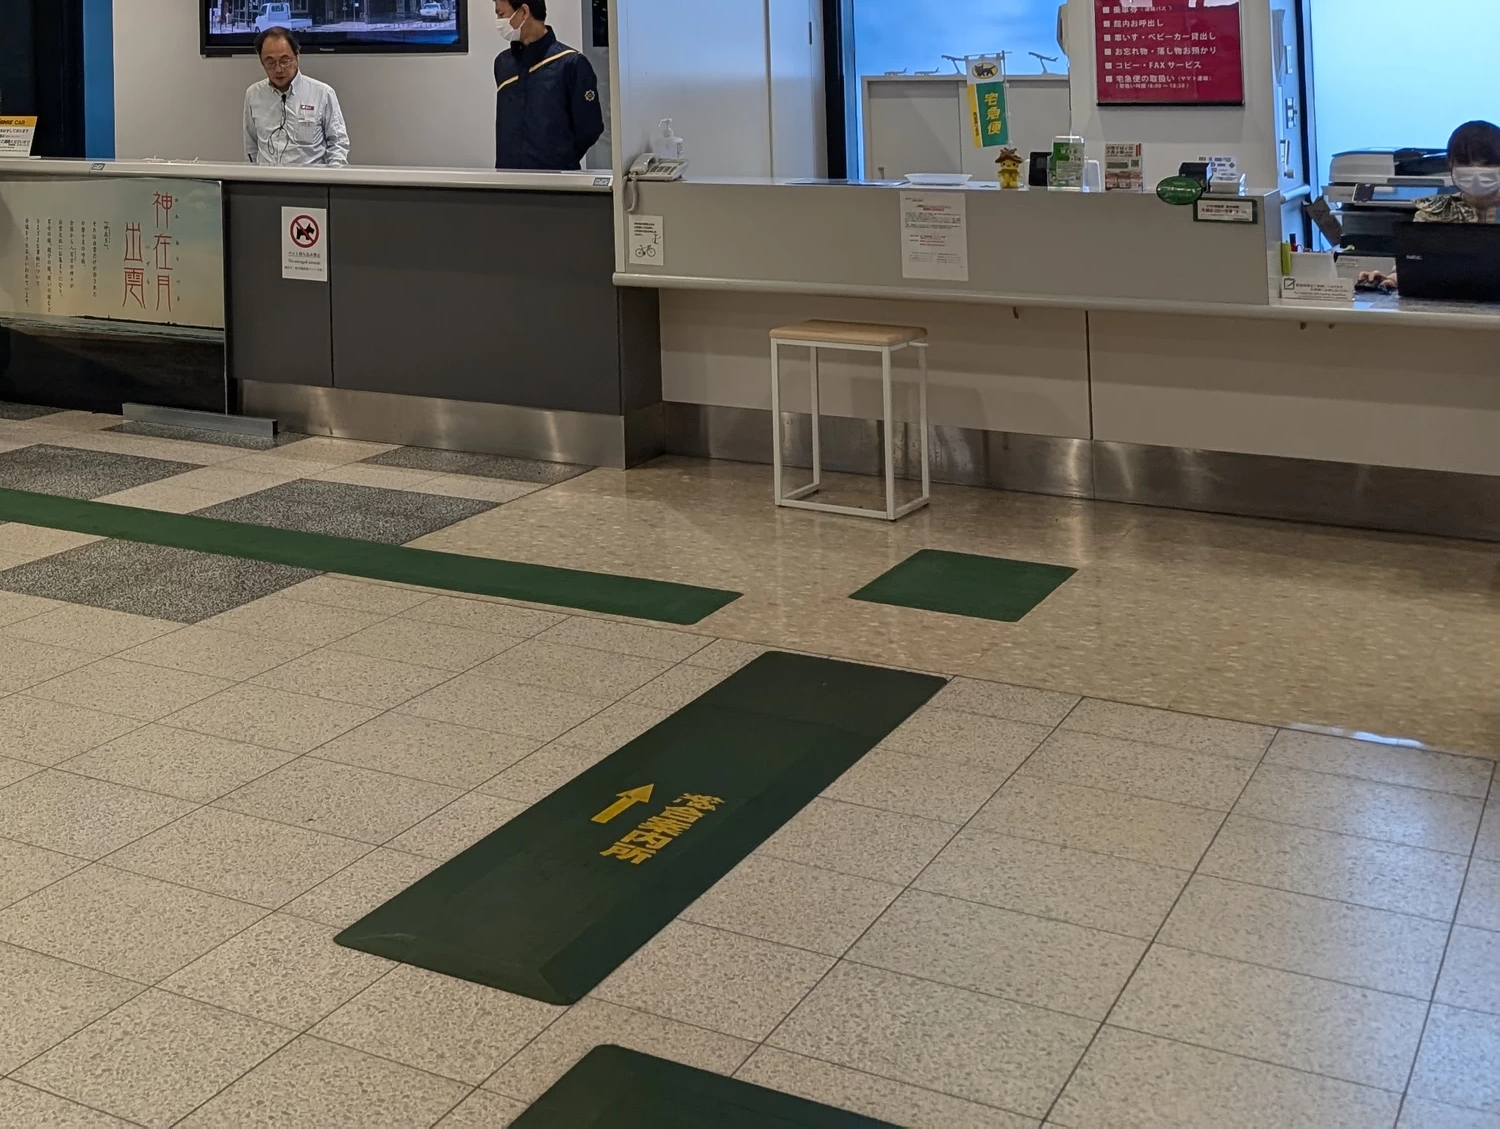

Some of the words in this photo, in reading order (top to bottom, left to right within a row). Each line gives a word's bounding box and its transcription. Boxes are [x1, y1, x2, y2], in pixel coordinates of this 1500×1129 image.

[1114, 19, 1164, 27] 館内お呼出し
[1114, 32, 1216, 41] 車いす・ベビーカー貸出し
[152, 191, 174, 312] 神在月
